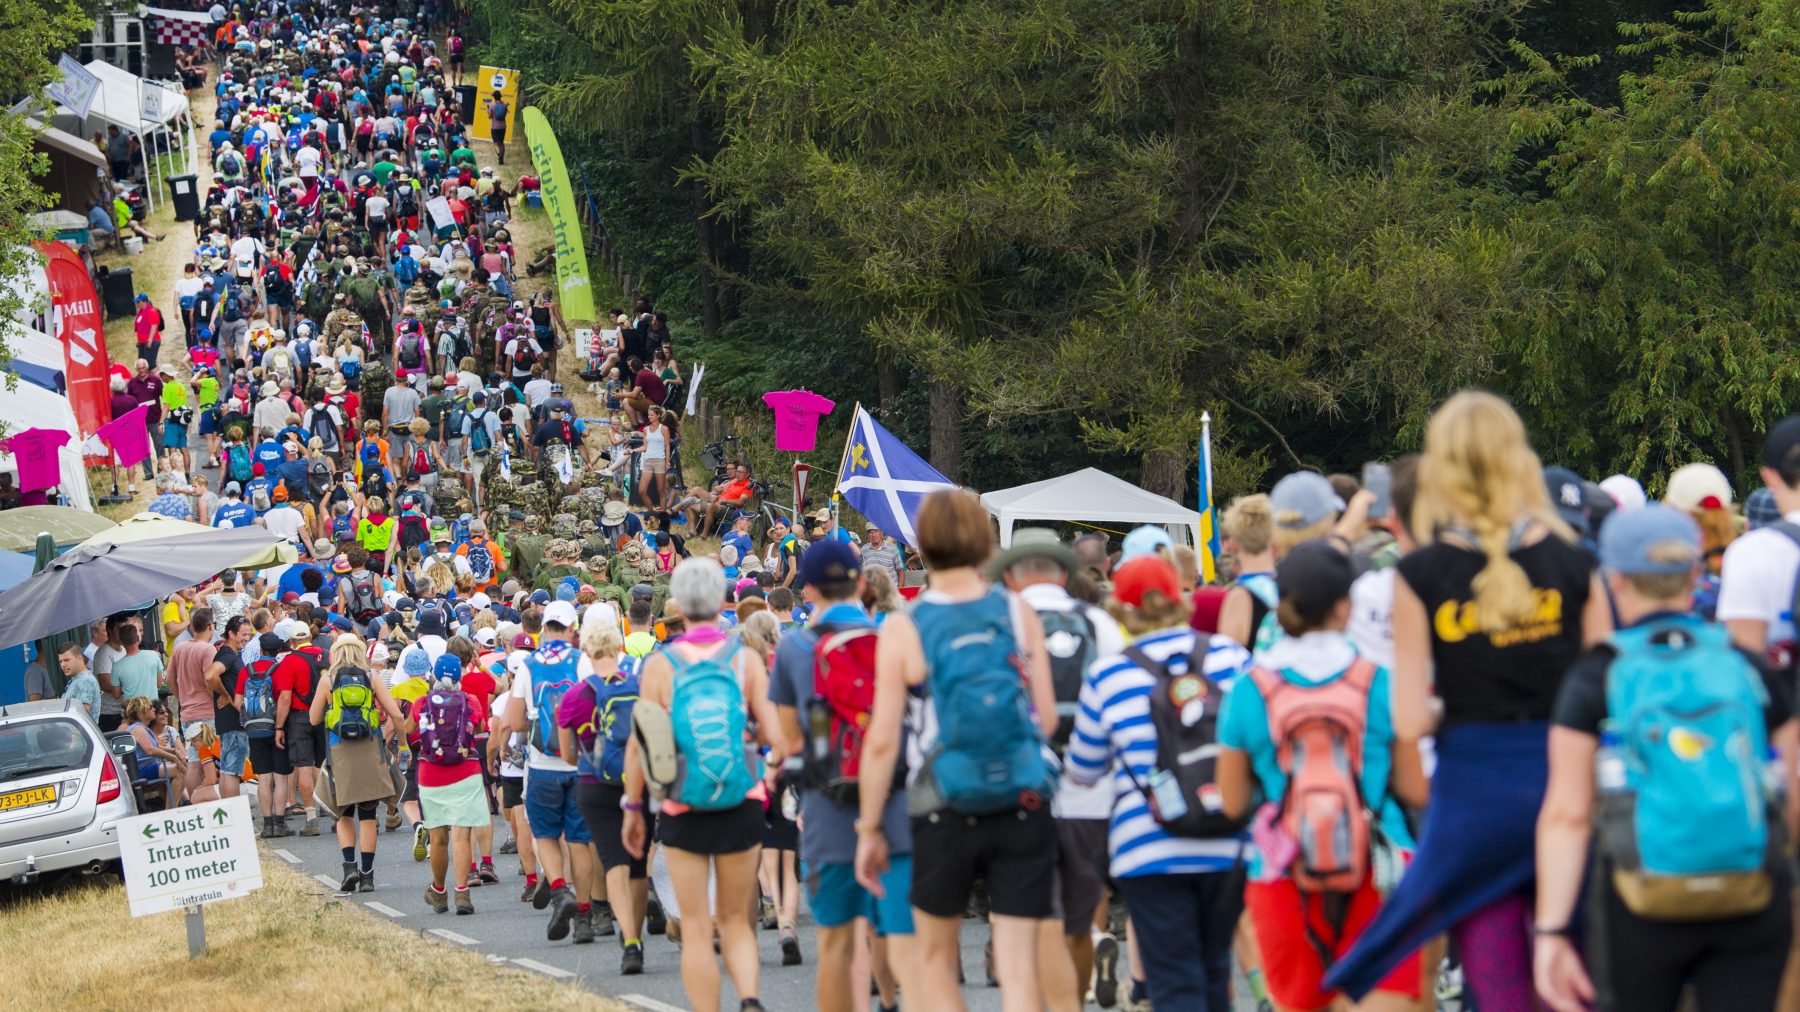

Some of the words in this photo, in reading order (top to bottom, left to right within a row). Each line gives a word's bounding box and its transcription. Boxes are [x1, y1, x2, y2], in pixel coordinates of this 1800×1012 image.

[64, 299, 94, 317] Mill
[164, 815, 205, 835] Rust
[147, 835, 230, 864] Intratuin
[147, 868, 180, 888] 100
[185, 859, 237, 880] meter
[181, 890, 223, 906] intratuin
